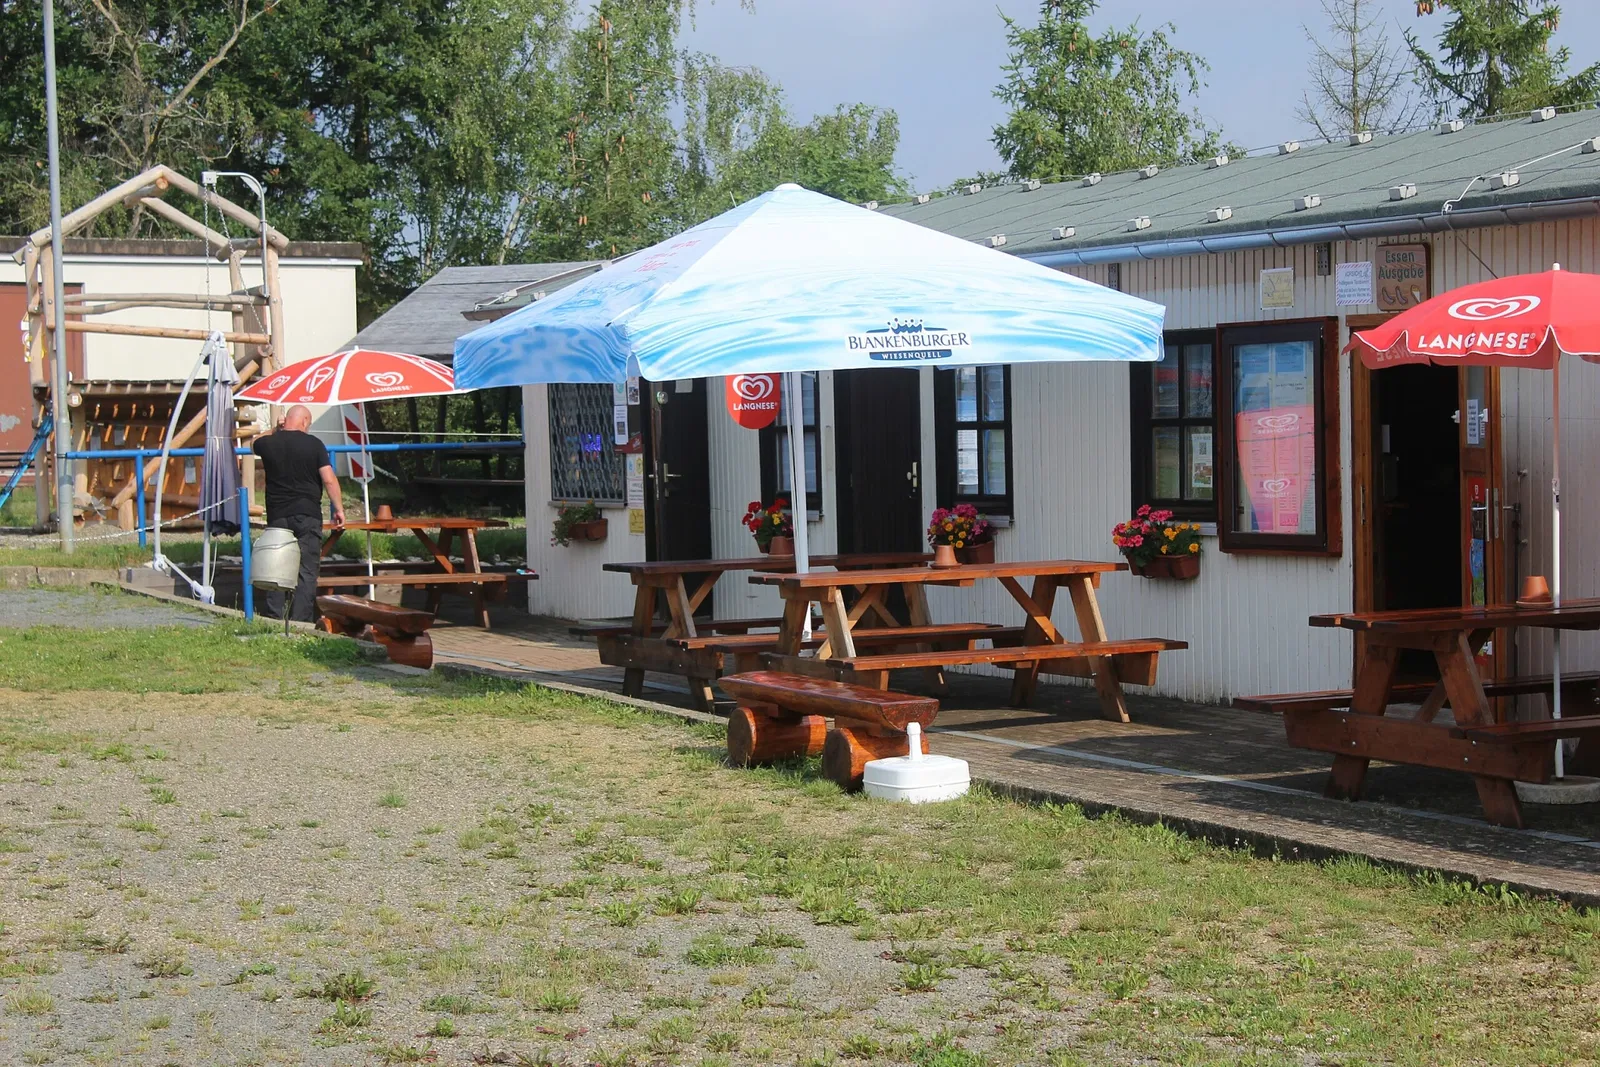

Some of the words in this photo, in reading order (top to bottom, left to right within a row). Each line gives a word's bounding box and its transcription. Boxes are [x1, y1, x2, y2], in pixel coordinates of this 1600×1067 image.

[1385, 250, 1415, 264] Essen
[1378, 265, 1424, 282] Ausgabe
[848, 332, 970, 350] BLANKENBURGER
[1418, 332, 1532, 350] LANGNESE
[881, 350, 942, 360] WIESENQUELL
[733, 402, 776, 411] LANGNESE
